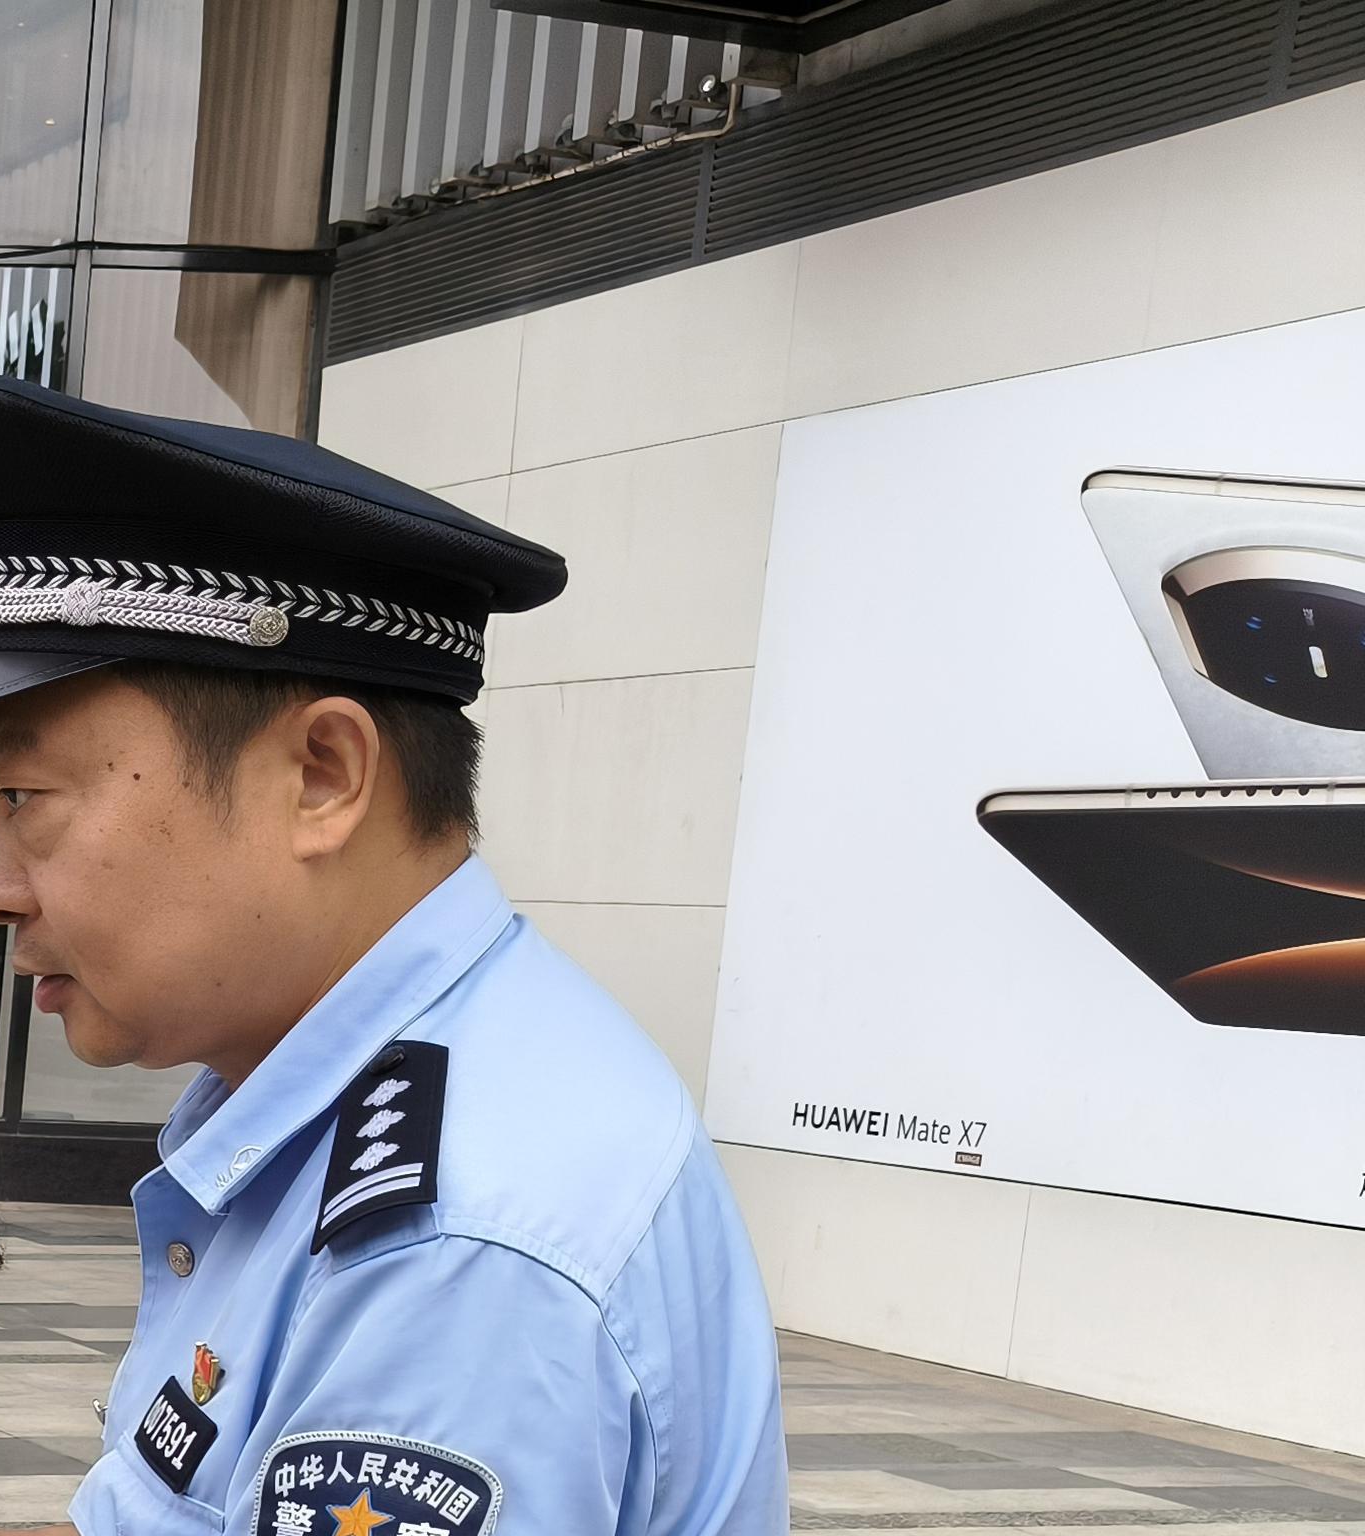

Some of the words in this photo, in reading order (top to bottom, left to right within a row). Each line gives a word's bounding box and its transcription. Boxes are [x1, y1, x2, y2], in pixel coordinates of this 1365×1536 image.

[792, 1102, 890, 1138] HUAWEI
[895, 1113, 952, 1146] Mate
[957, 1119, 988, 1149] X7
[274, 1449, 480, 1524] 中华人民共和国
